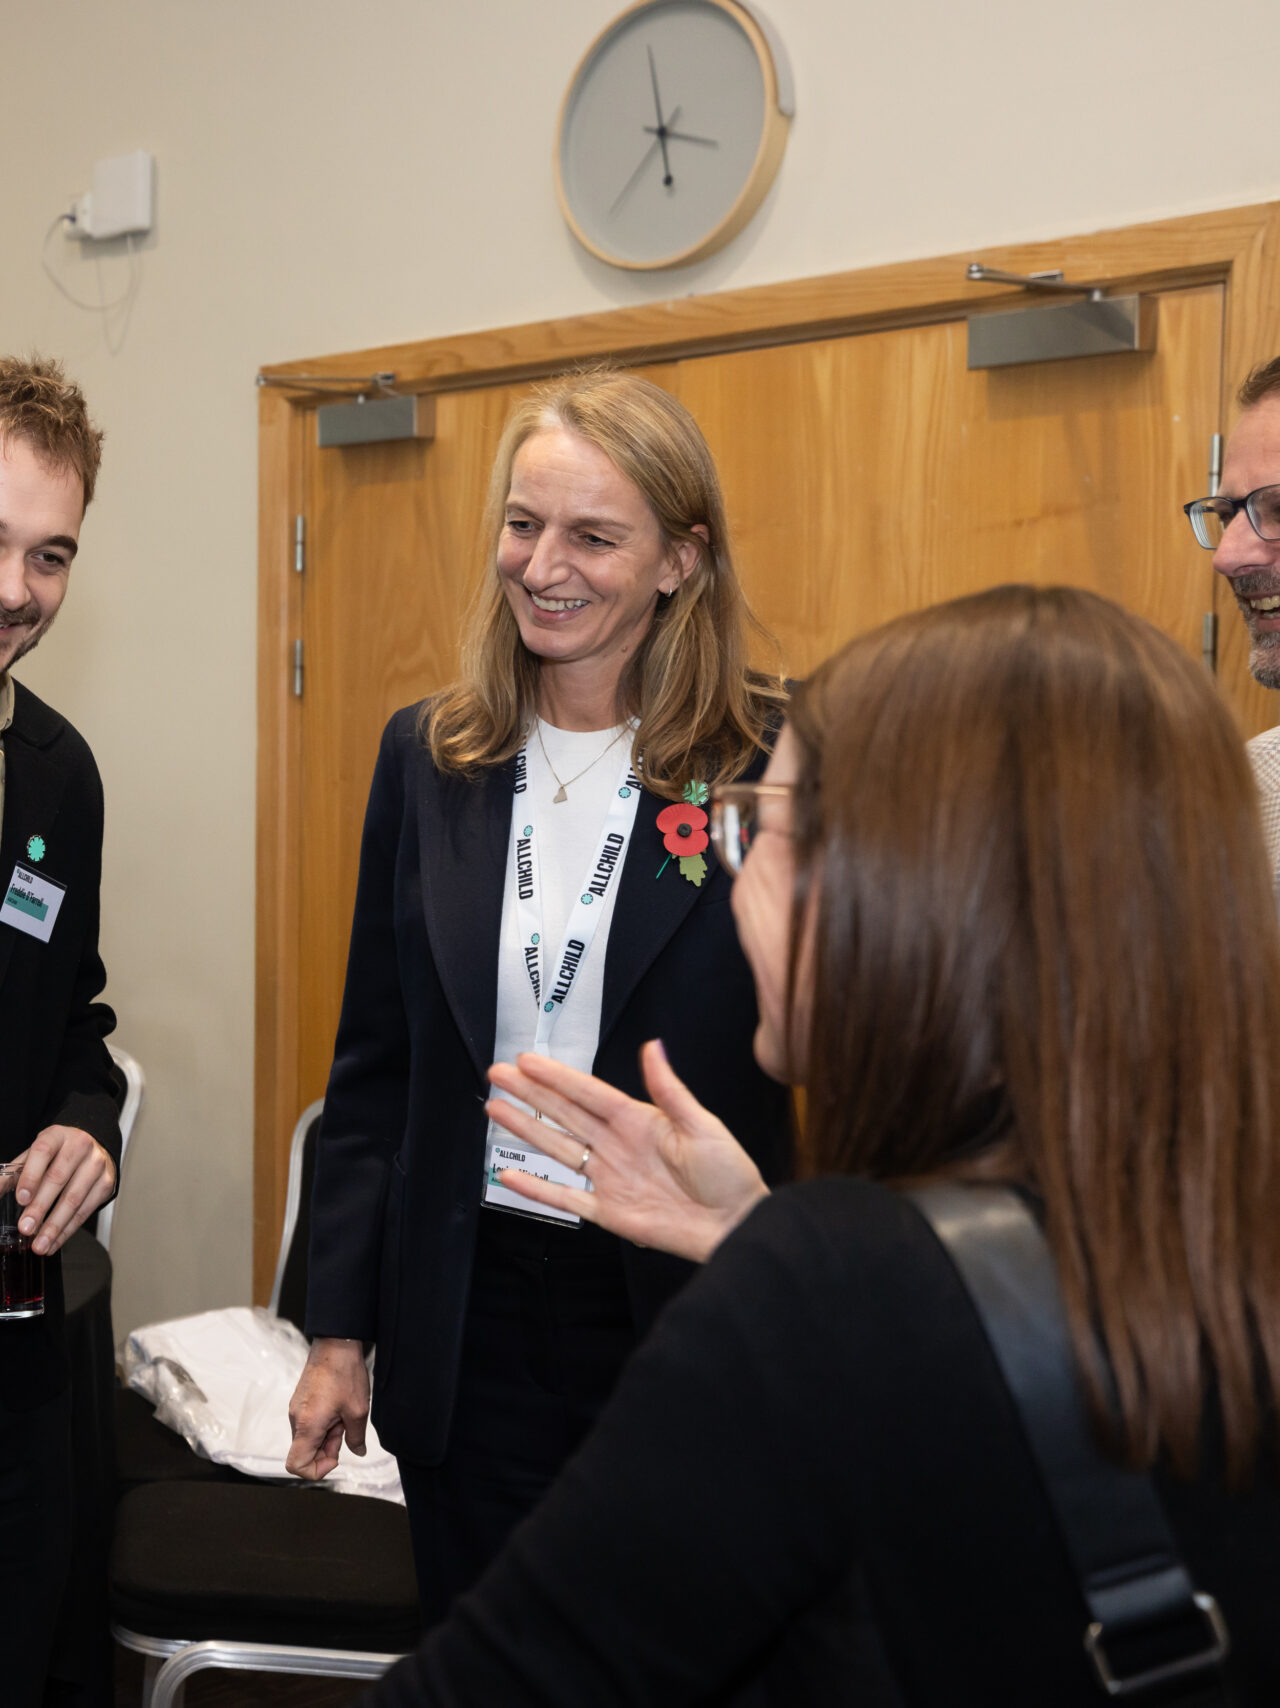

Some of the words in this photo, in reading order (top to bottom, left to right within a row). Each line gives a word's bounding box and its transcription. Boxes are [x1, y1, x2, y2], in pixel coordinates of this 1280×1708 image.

[516, 838, 534, 900] ALLCHILD
[589, 832, 625, 897] ALLCHILD
[551, 939, 585, 1004] ALLCHILD
[499, 1150, 526, 1162] ALLCHILD
